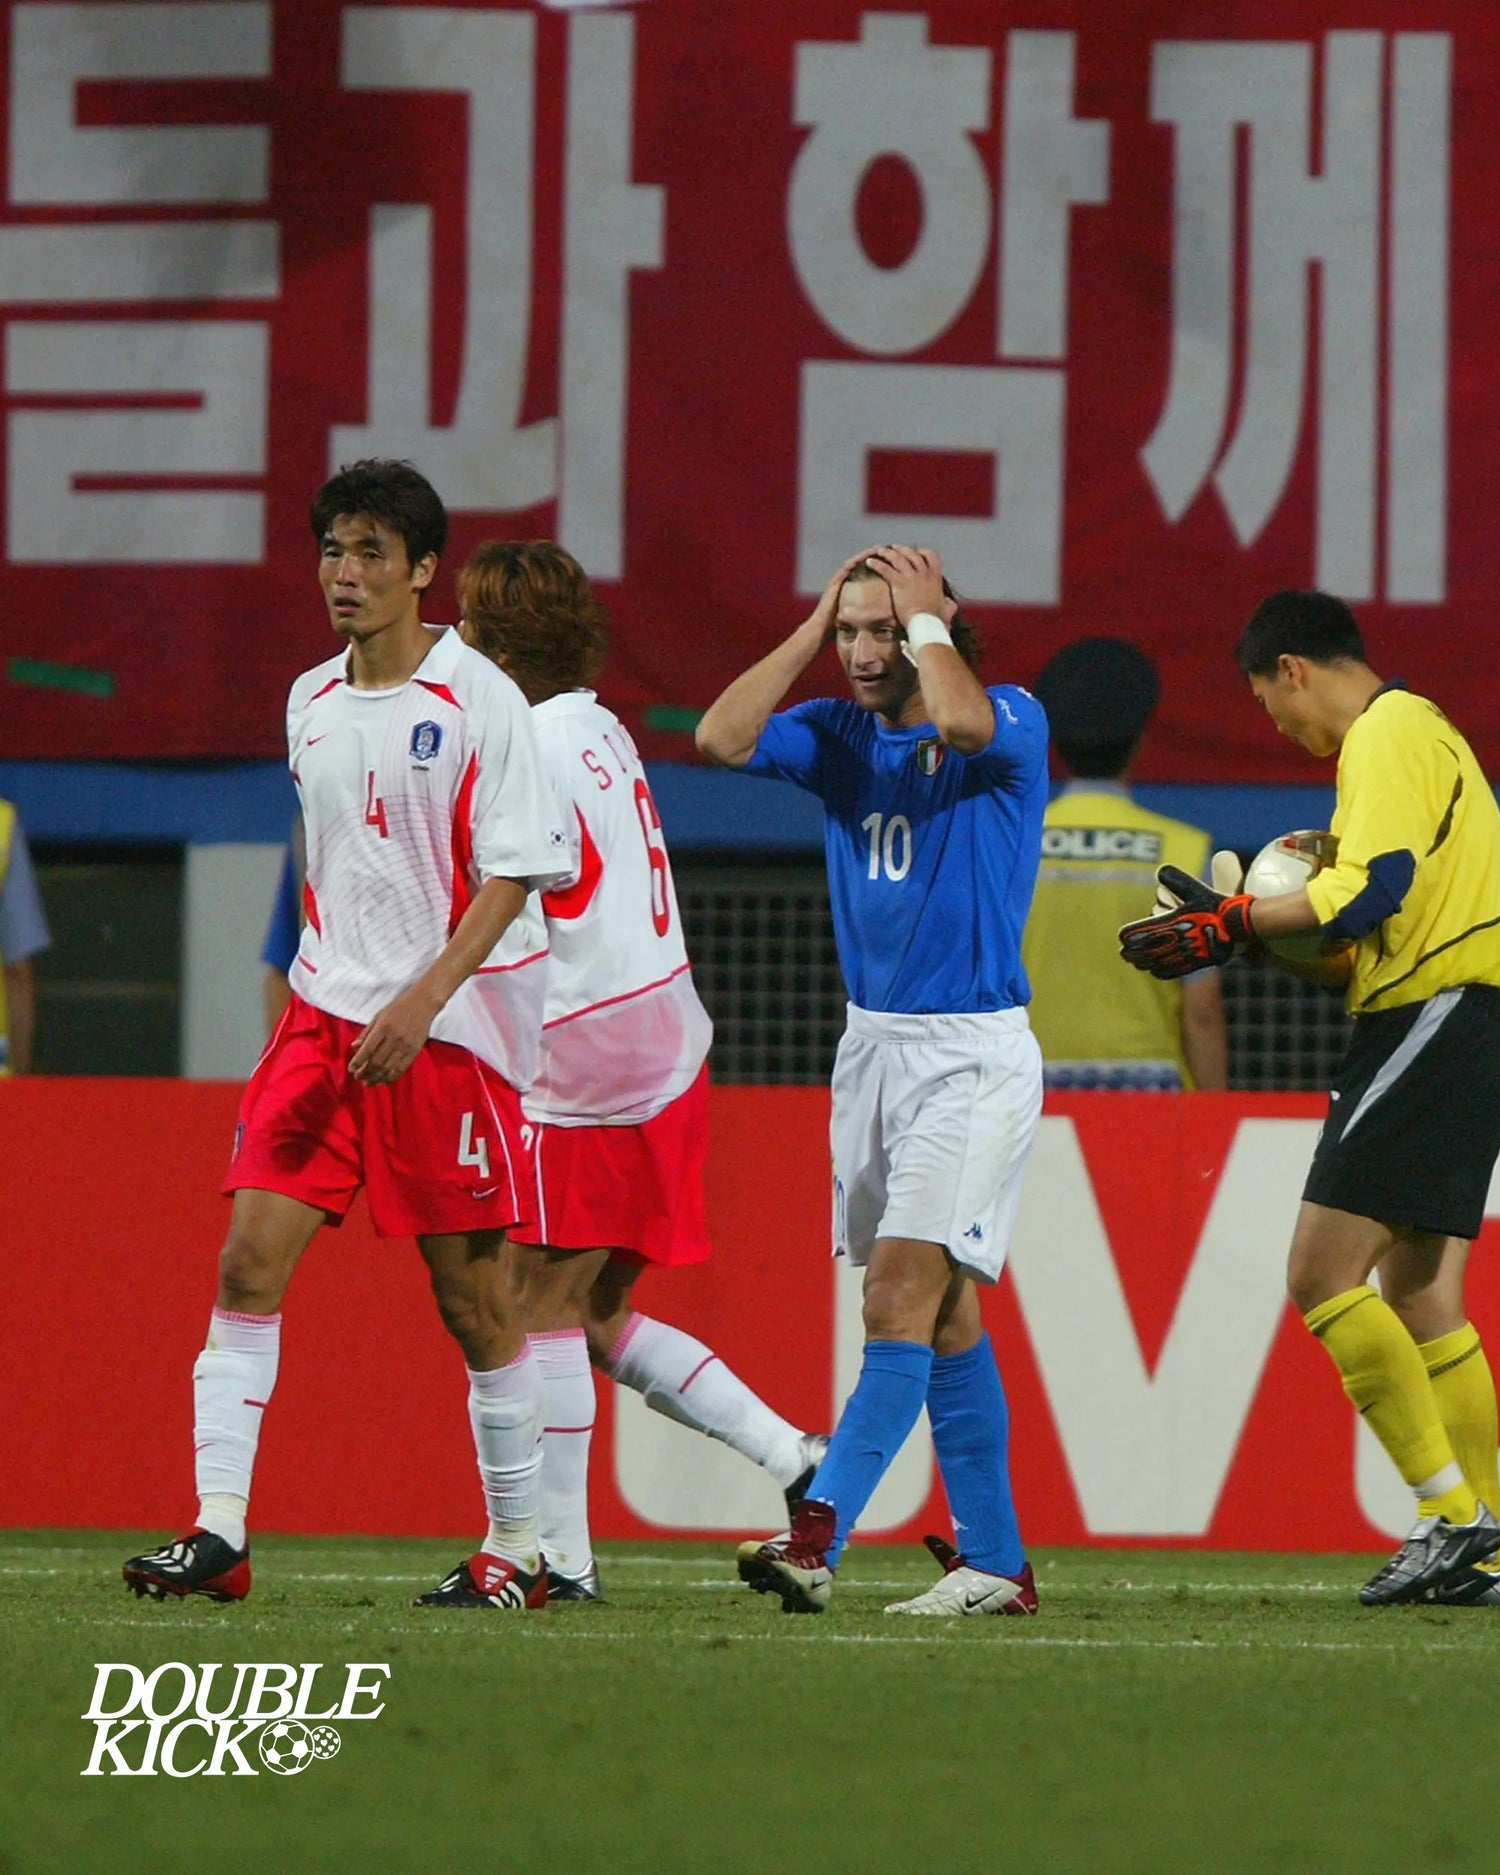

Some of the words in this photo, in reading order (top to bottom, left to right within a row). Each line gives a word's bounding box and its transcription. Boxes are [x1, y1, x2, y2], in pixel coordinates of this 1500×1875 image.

[0, 3, 667, 580] 들과
[787, 11, 1453, 606] 함께
[365, 770, 389, 838] 4
[634, 777, 670, 938] 6
[861, 812, 912, 882] 10
[1041, 827, 1161, 861] OLICE
[457, 1111, 490, 1179] 4
